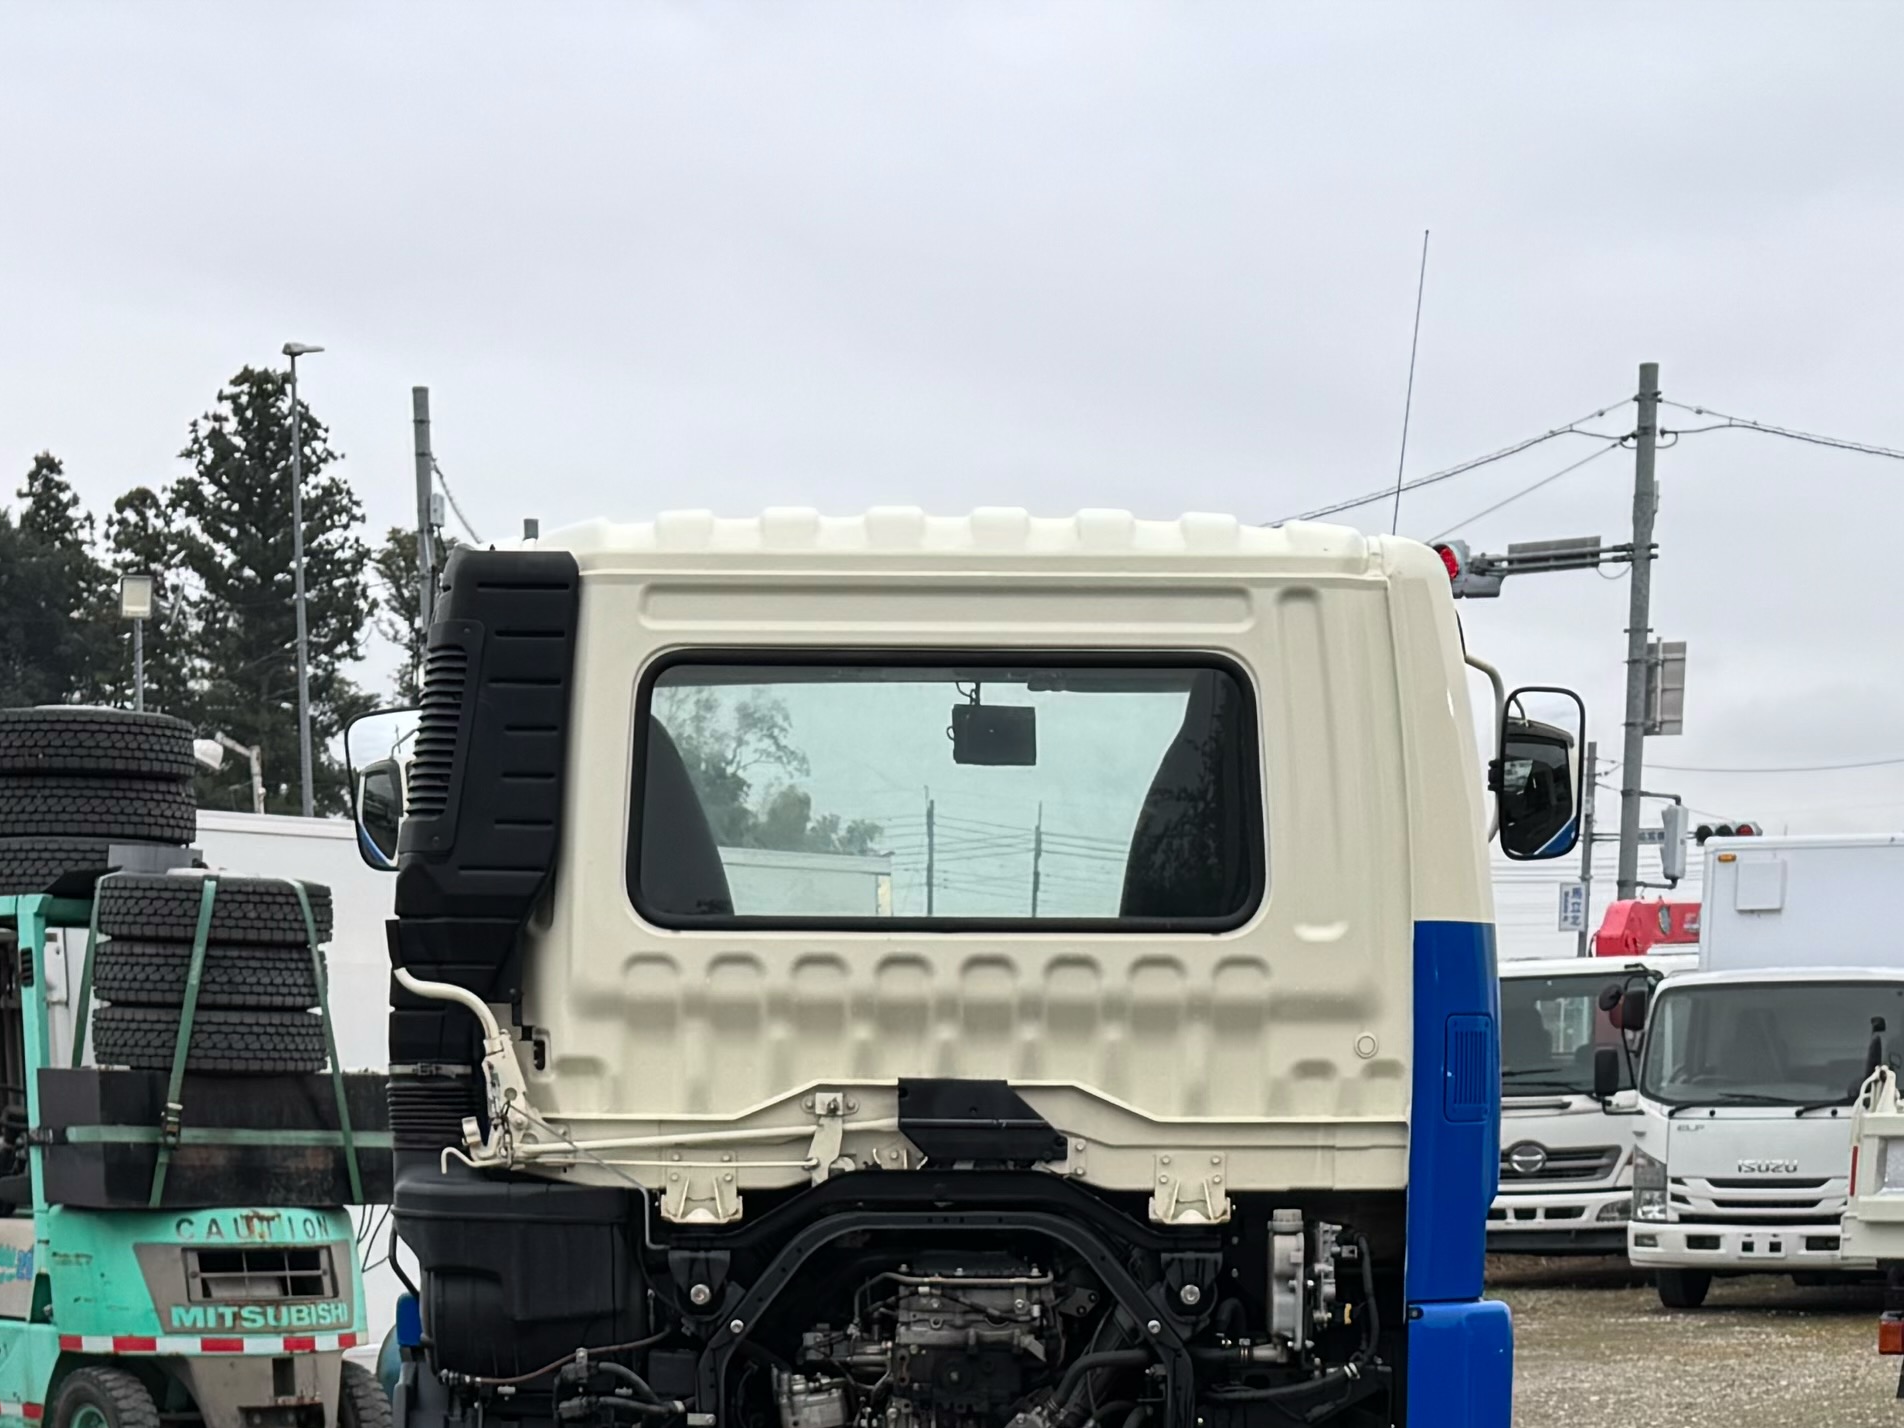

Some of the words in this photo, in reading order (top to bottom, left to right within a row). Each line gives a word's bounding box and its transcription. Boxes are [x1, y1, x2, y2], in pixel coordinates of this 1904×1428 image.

[1737, 1159, 1798, 1173] ISUZU
[175, 1213, 330, 1241] CAUTION
[170, 1303, 347, 1329] MITSUBISHI
